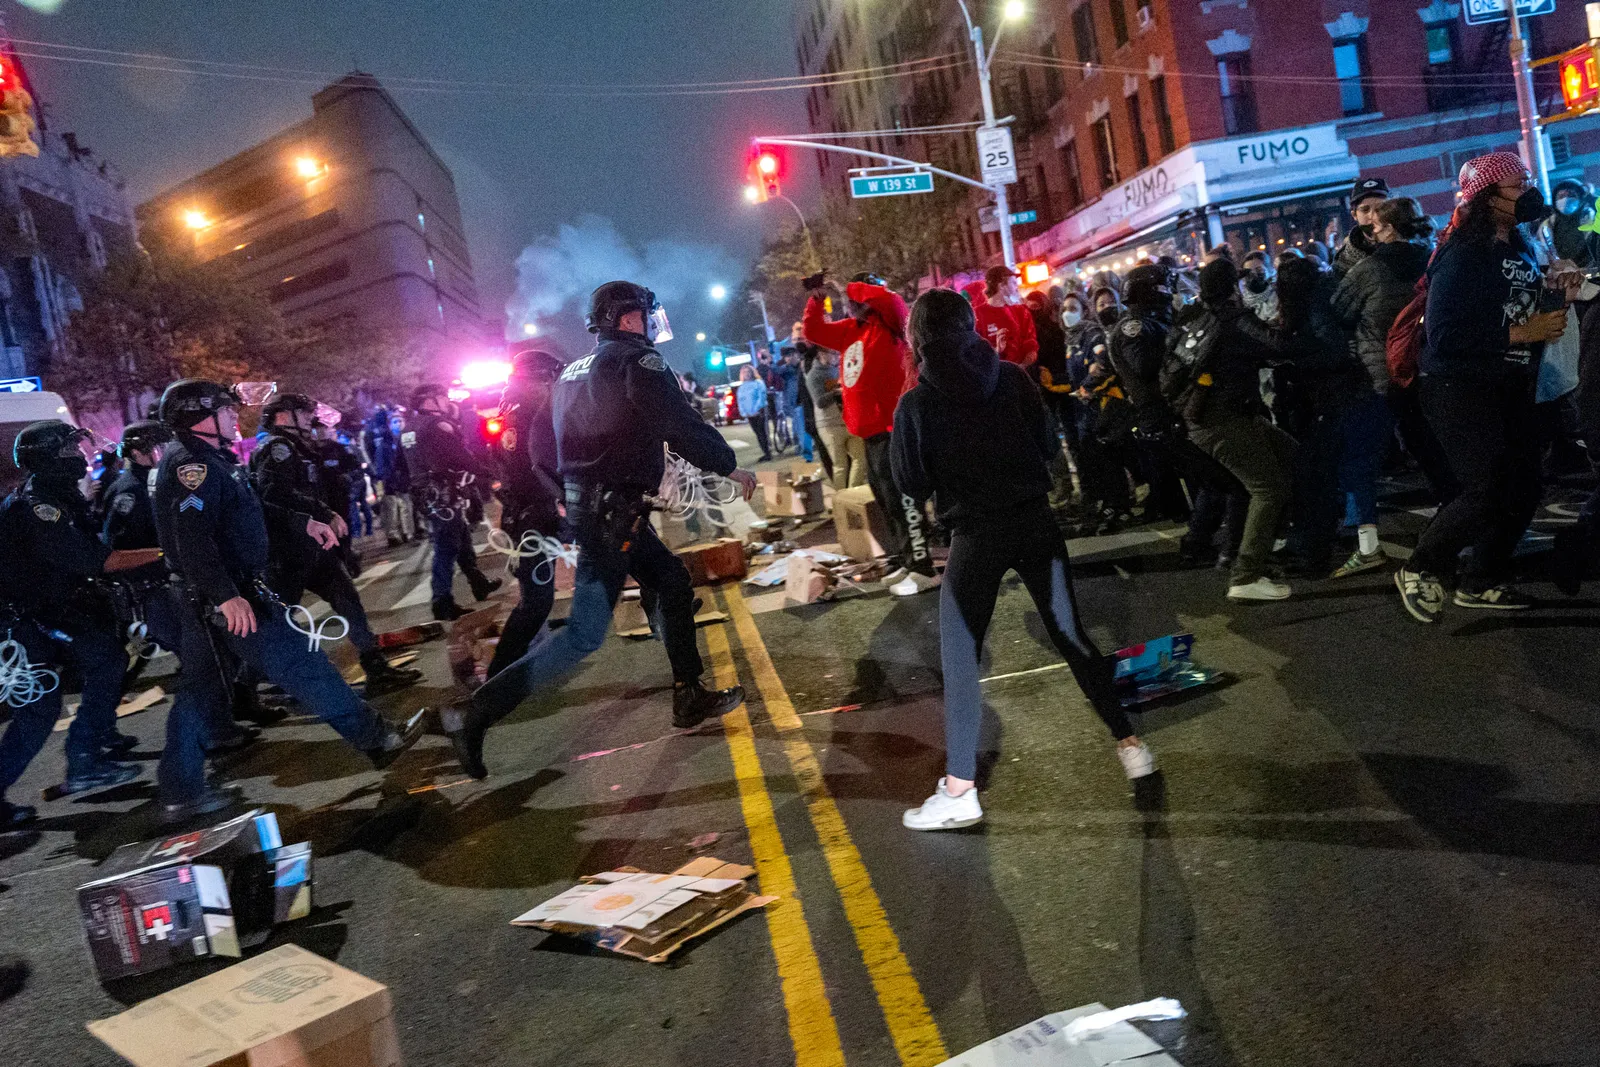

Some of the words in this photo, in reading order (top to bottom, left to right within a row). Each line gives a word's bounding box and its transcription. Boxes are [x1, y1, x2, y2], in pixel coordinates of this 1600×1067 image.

[985, 151, 1010, 168] 25
[1238, 137, 1309, 164] FUMO
[868, 181, 879, 192] W
[883, 179, 901, 191] 139
[905, 178, 917, 189] St
[1125, 167, 1169, 211] FUMO
